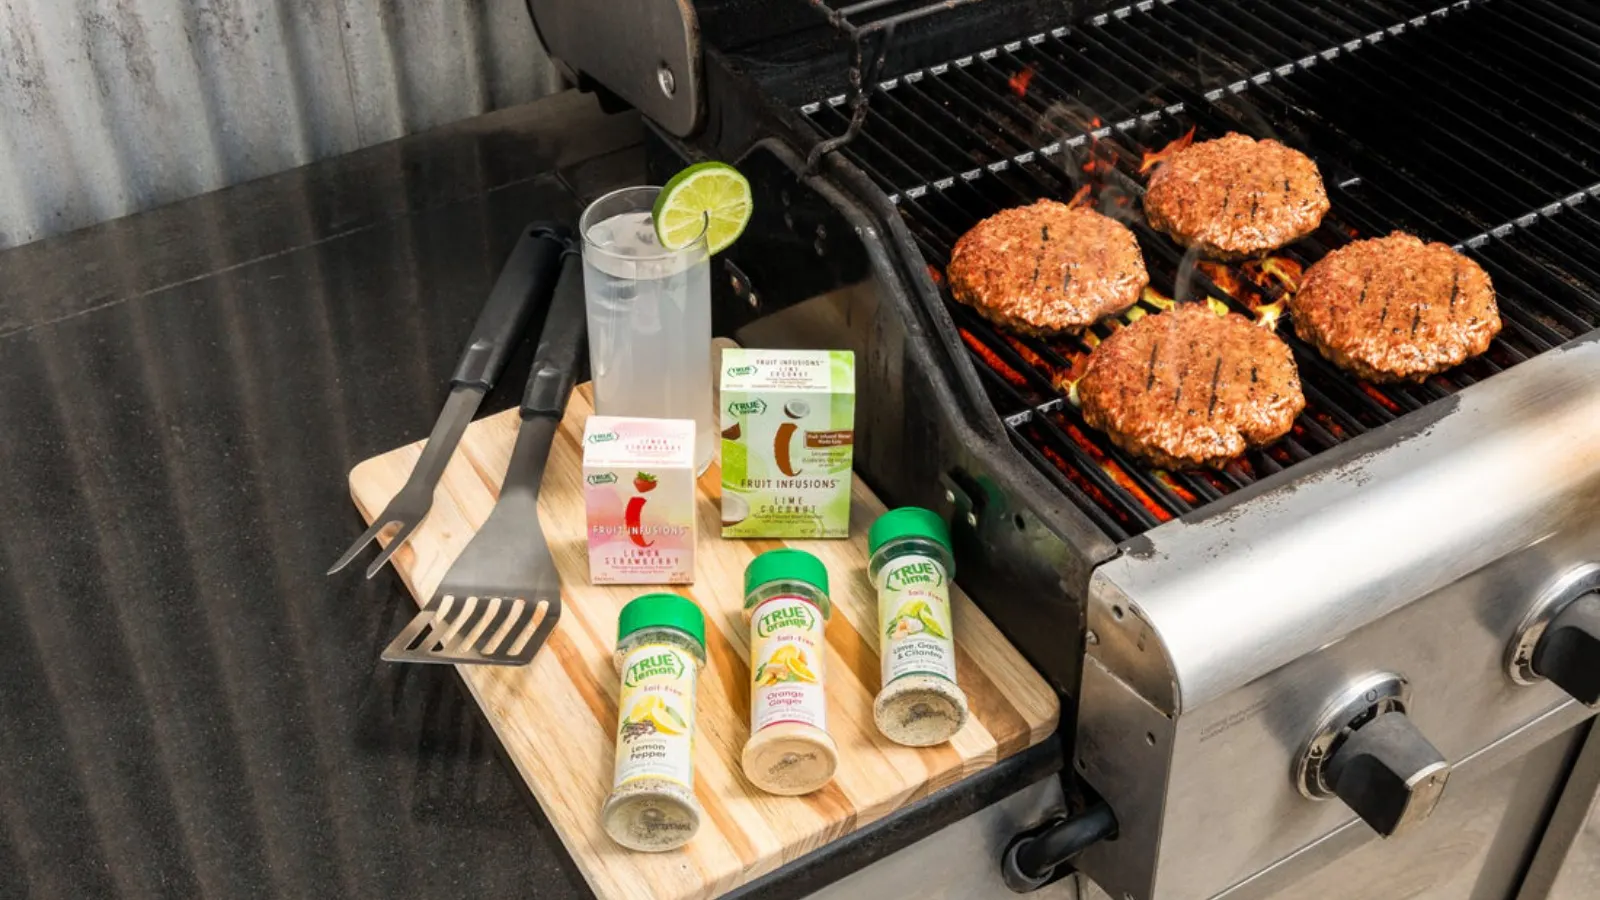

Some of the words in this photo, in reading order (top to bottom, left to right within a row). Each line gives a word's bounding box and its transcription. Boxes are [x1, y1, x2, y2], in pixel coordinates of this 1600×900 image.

[735, 401, 760, 411] TRUE
[741, 478, 772, 489] FRUIT
[776, 479, 836, 489] INFUSIONS
[774, 496, 803, 505] LIME
[760, 505, 817, 513] COCONUT
[592, 525, 623, 534] FRUIT
[627, 526, 687, 536] INFUSIONS
[623, 549, 660, 557] LEMON
[604, 557, 679, 565] STRAWBERRY
[891, 563, 934, 580] TRUE
[762, 606, 806, 625] TRUE
[766, 618, 807, 633] orange
[917, 642, 944, 654] Garlic
[904, 650, 943, 659] Cilantro
[630, 653, 675, 675] TRUE
[634, 666, 676, 682] lemon
[766, 691, 805, 701] Orange
[768, 698, 803, 707] Ginger
[630, 743, 666, 754] Lemon
[629, 751, 667, 761] Pepper
